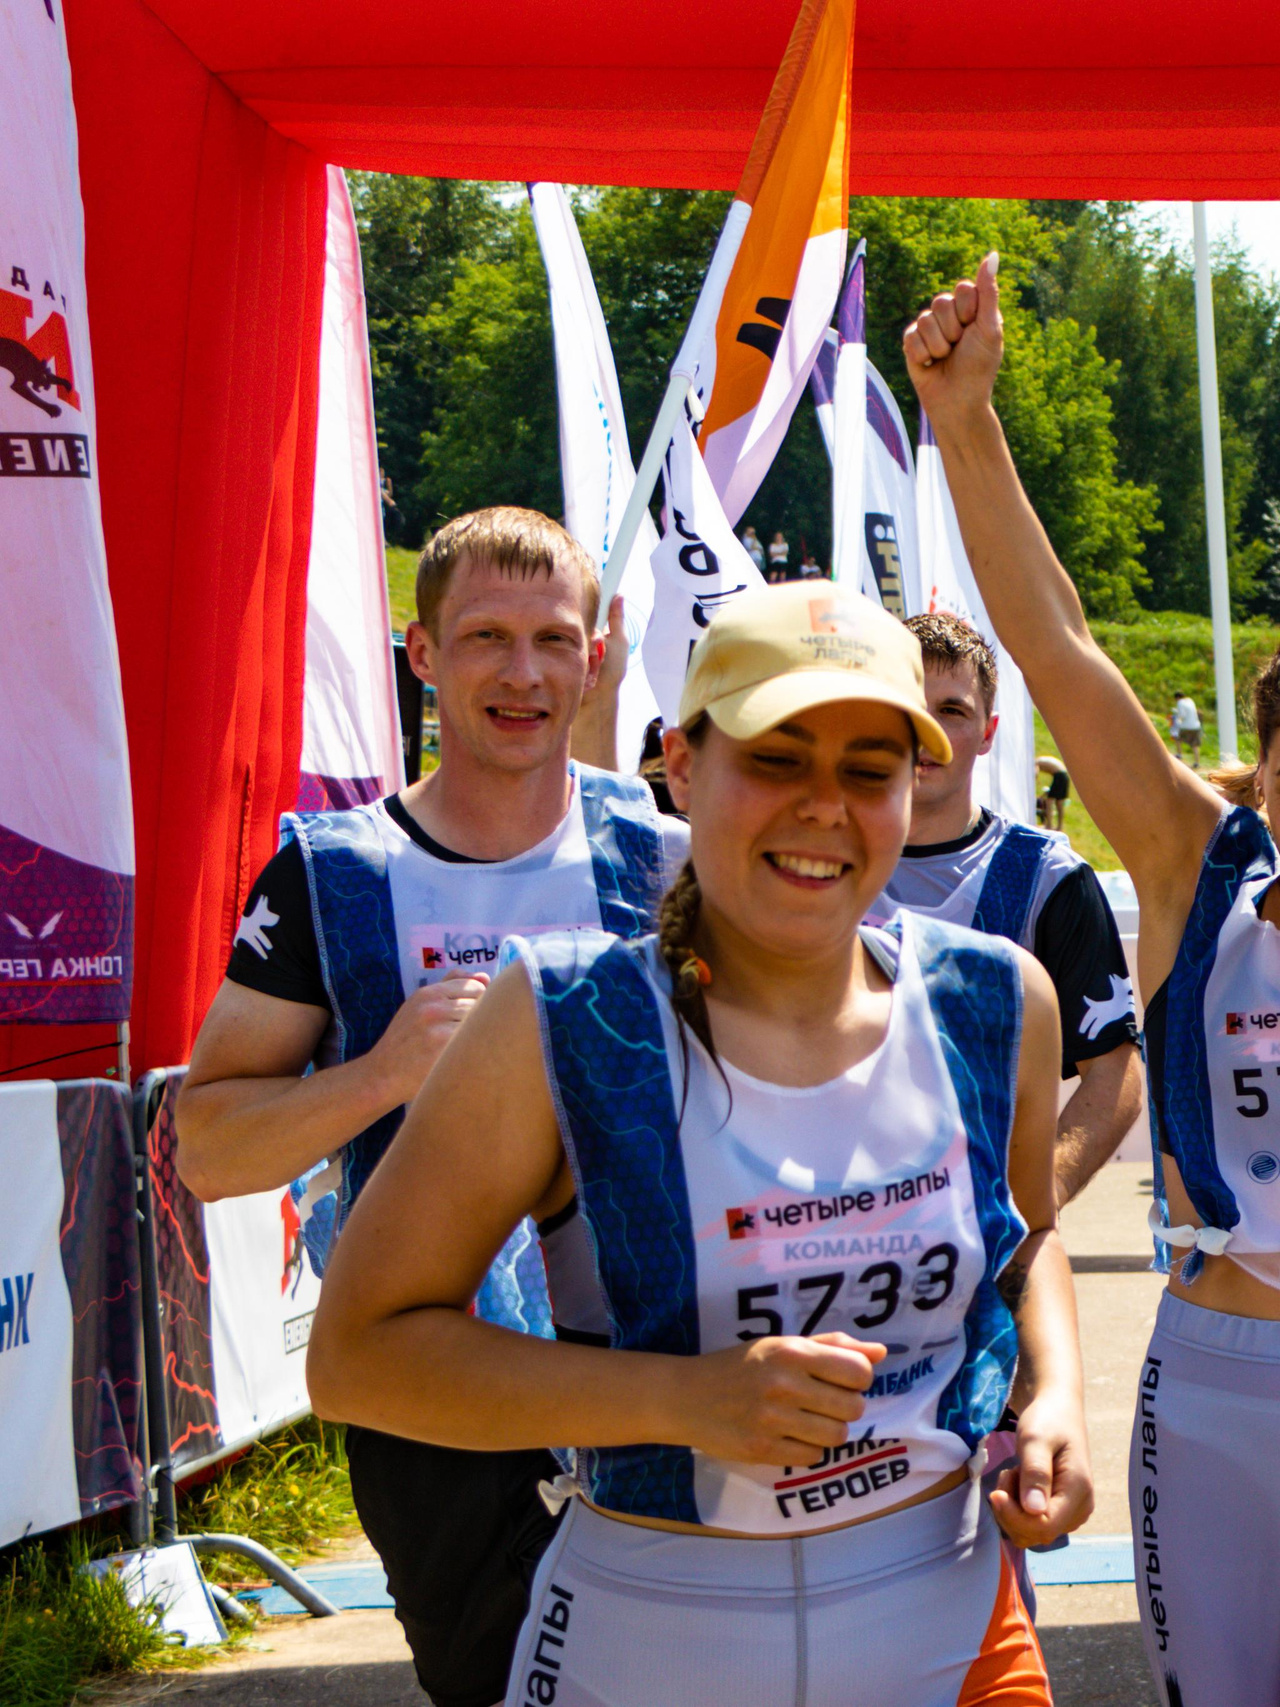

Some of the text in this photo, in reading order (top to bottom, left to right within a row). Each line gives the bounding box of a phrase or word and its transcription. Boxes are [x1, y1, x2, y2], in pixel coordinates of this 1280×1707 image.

[764, 1167, 951, 1228] четыре лапы
[784, 1233, 924, 1262] КОМАНДА
[736, 1242, 960, 1342] 5733
[775, 1458, 911, 1519] ГЕРОЕВ
[1141, 1356, 1171, 1652] четыре лапы
[524, 1583, 575, 1707] апы
